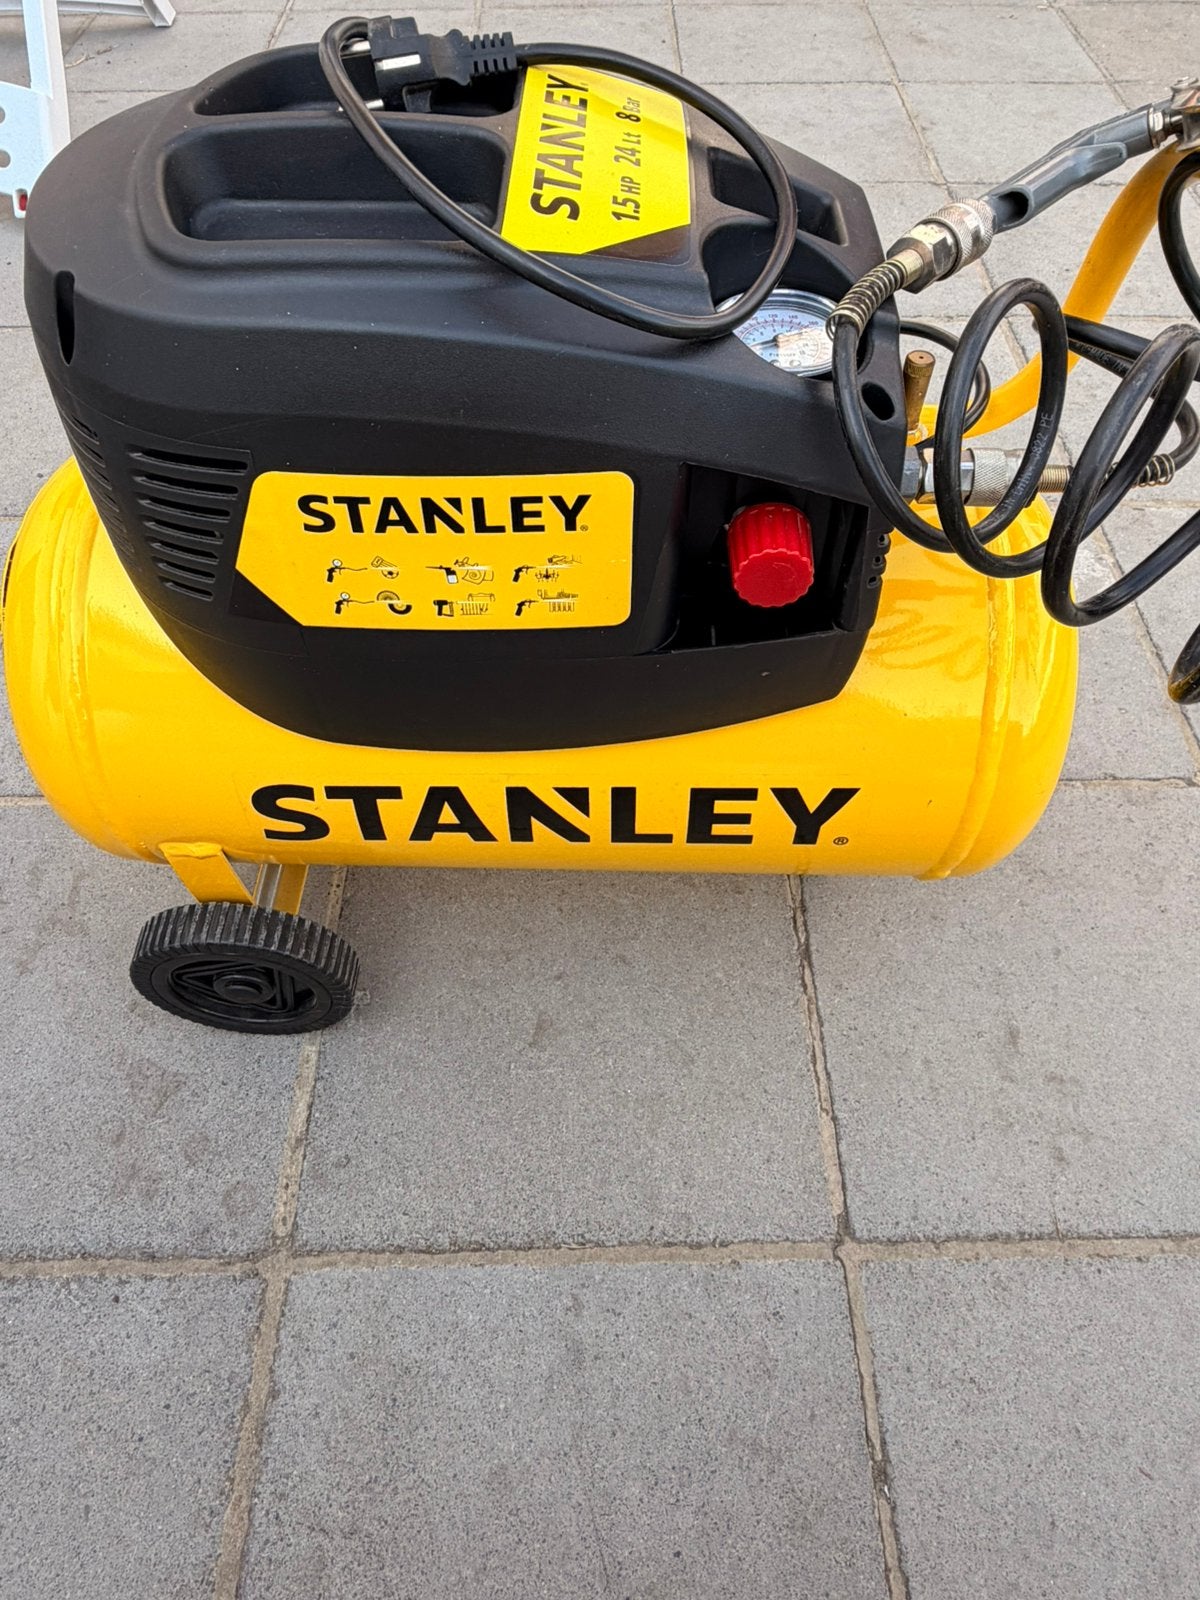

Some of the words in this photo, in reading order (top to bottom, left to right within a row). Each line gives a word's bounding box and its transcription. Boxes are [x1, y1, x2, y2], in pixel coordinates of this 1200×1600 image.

[615, 111, 642, 122] 8
[530, 74, 589, 221] STANLEY
[613, 146, 642, 167] 24
[620, 176, 641, 195] HP
[611, 195, 641, 221] 1.5
[297, 494, 591, 533] STANLEY
[250, 784, 861, 845] STANLEY
